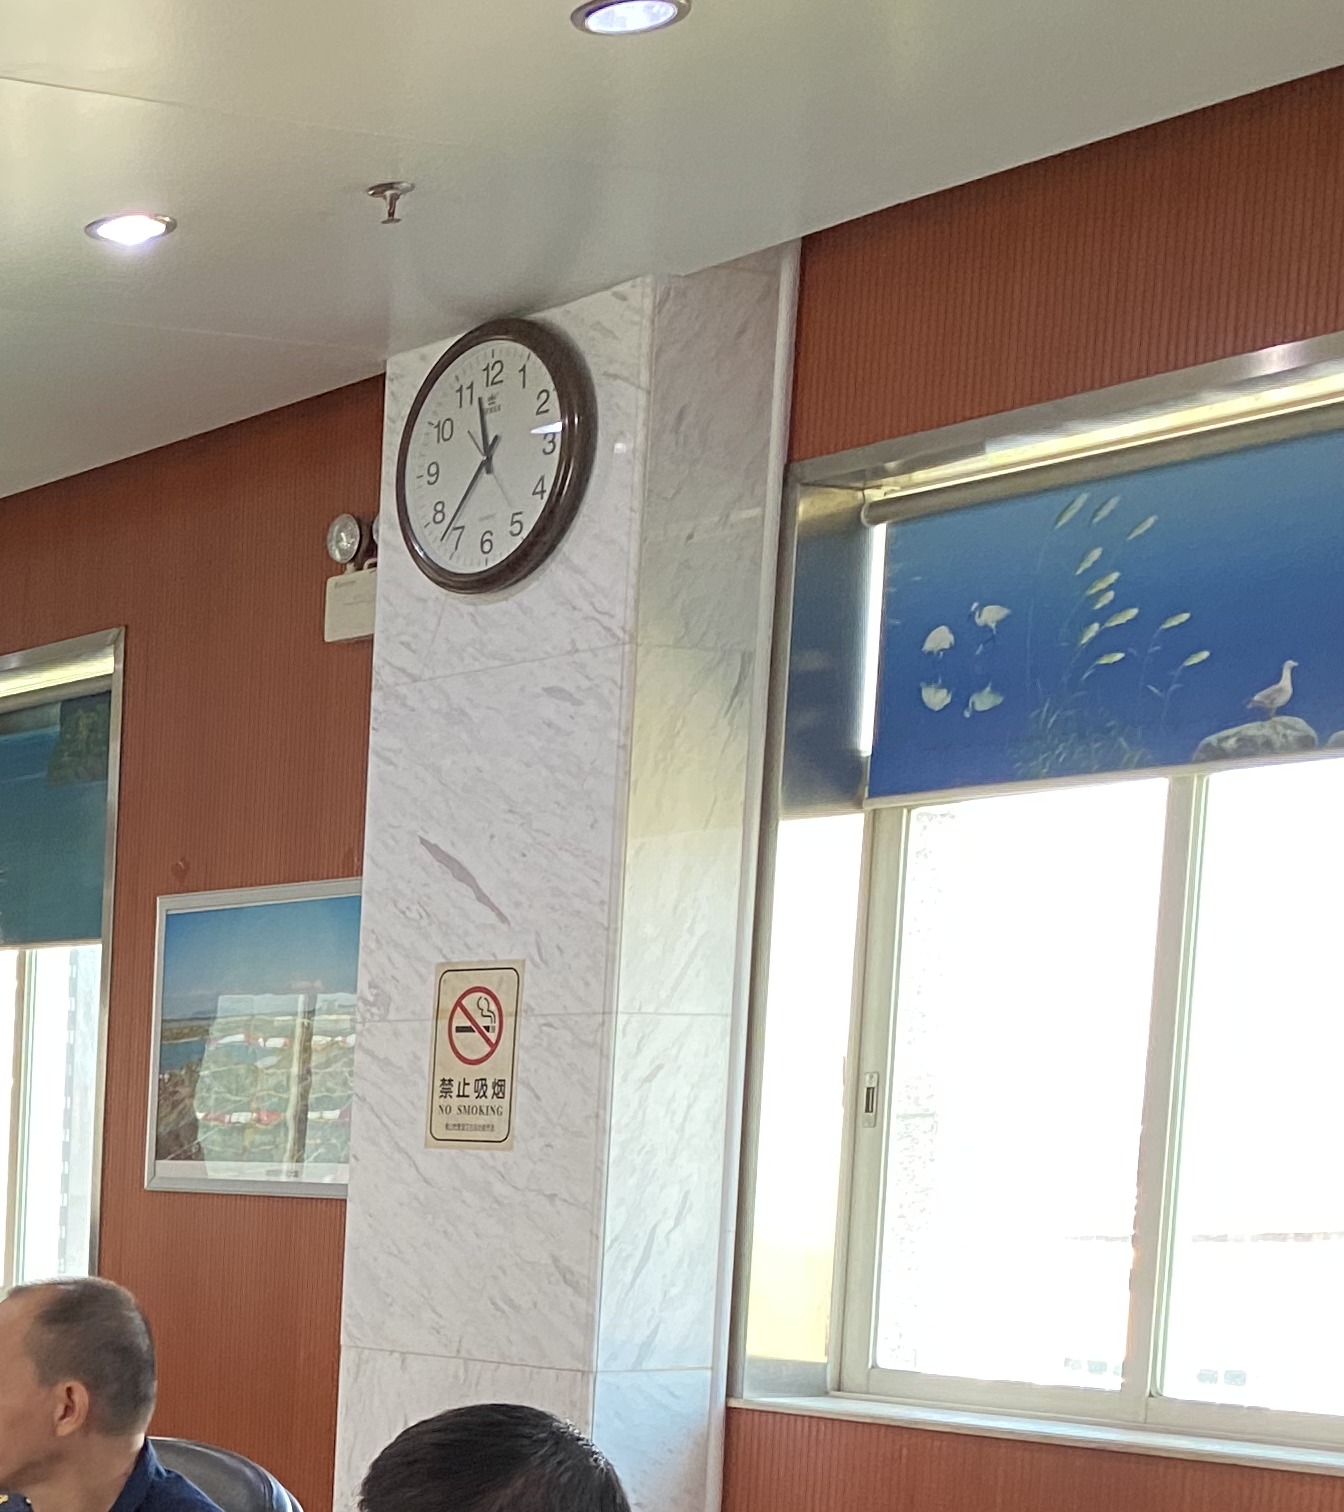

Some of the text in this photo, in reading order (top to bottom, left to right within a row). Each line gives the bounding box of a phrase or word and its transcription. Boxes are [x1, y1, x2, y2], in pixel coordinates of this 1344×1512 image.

[483, 360, 504, 388] 12
[518, 365, 527, 389] 1
[455, 382, 475, 409] 11
[535, 389, 551, 416] 2
[434, 418, 454, 444] 10
[542, 431, 556, 456] 3
[426, 461, 440, 486] 9
[531, 475, 547, 501] 4
[432, 501, 446, 525] 8
[509, 511, 524, 537] 5
[452, 525, 466, 551] 7
[480, 530, 494, 555] 6
[439, 1077, 506, 1100] 禁止吸烟
[438, 1104, 504, 1117] NO SMOKING
